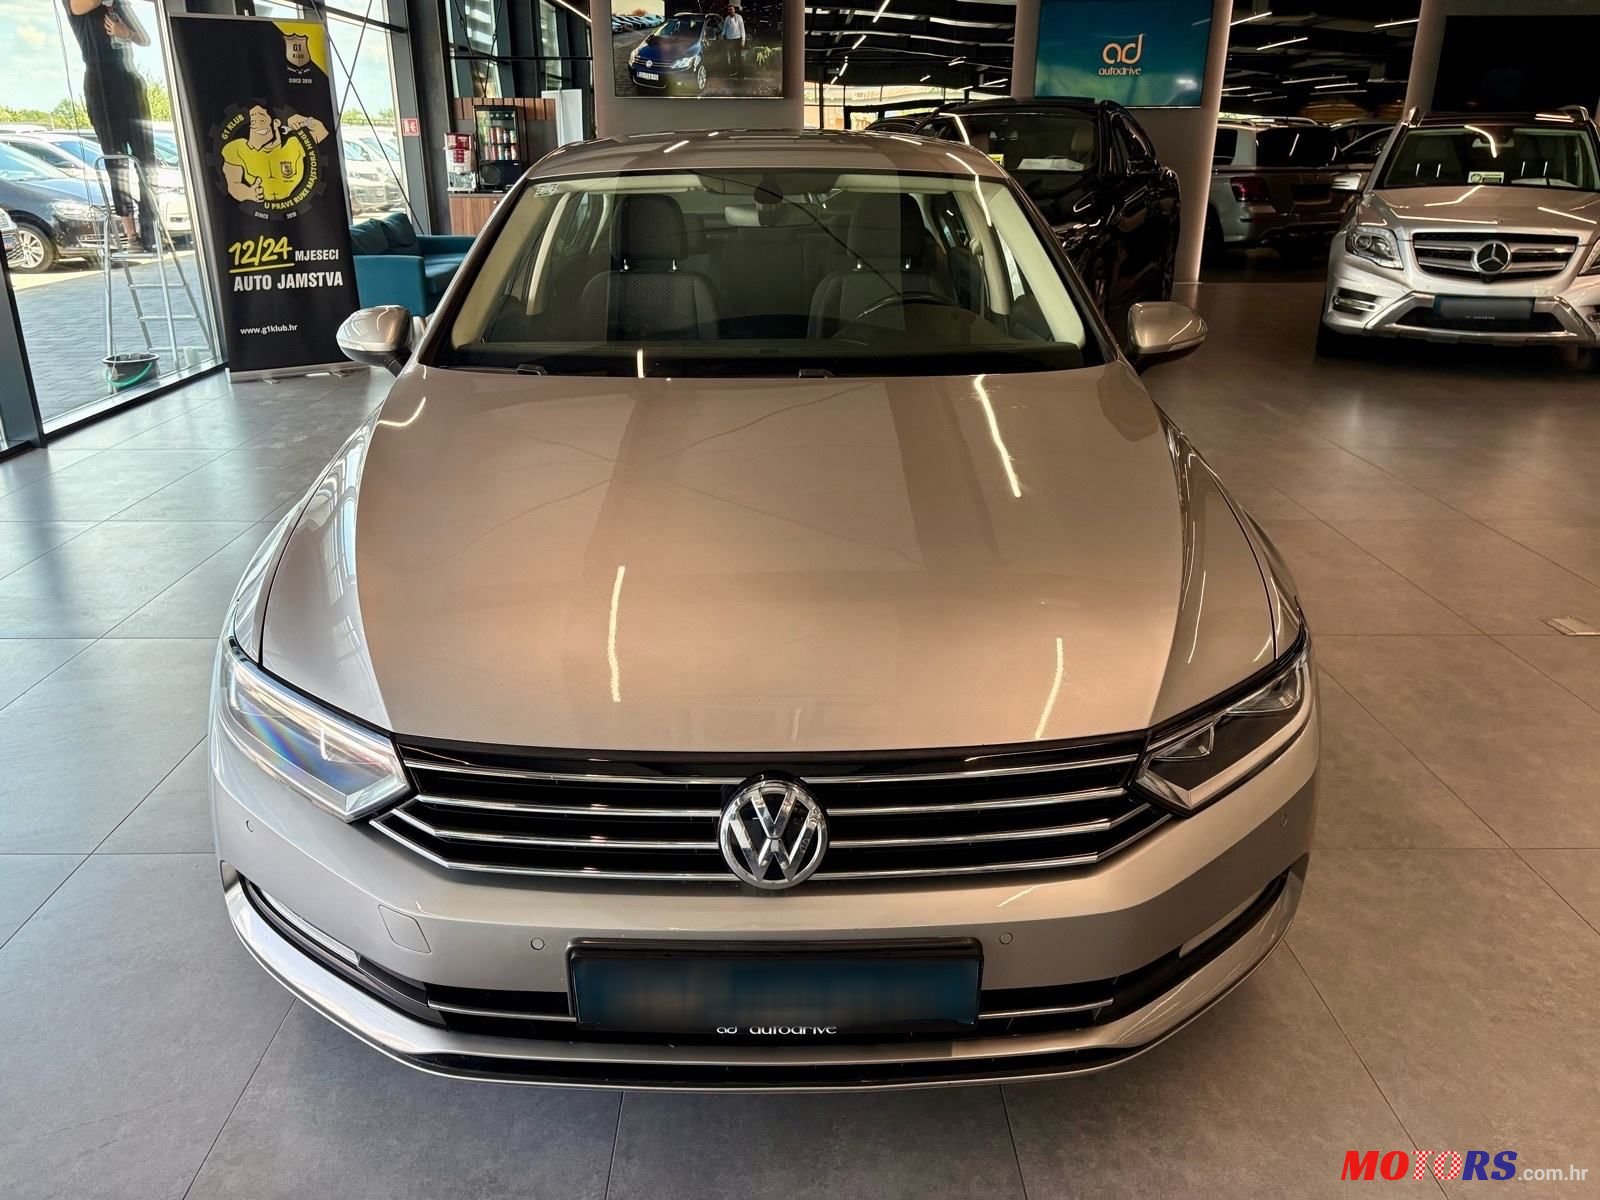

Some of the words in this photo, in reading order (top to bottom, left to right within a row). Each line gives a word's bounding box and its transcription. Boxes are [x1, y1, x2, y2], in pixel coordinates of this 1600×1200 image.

[1099, 67, 1141, 75] autodrive
[221, 129, 230, 140] G1
[226, 114, 245, 130] KLUB
[271, 200, 295, 210] PRAVE
[293, 188, 309, 204] RUKE
[307, 151, 318, 190] MAJSTORA
[254, 211, 269, 220] SINCE
[228, 235, 293, 266] 12/24
[295, 249, 339, 261] MJESECI
[233, 274, 272, 292] AUTO
[277, 271, 344, 290] JAMSTVA
[240, 324, 298, 335] www.g1klub.hr
[749, 1026, 837, 1035] autodrive
